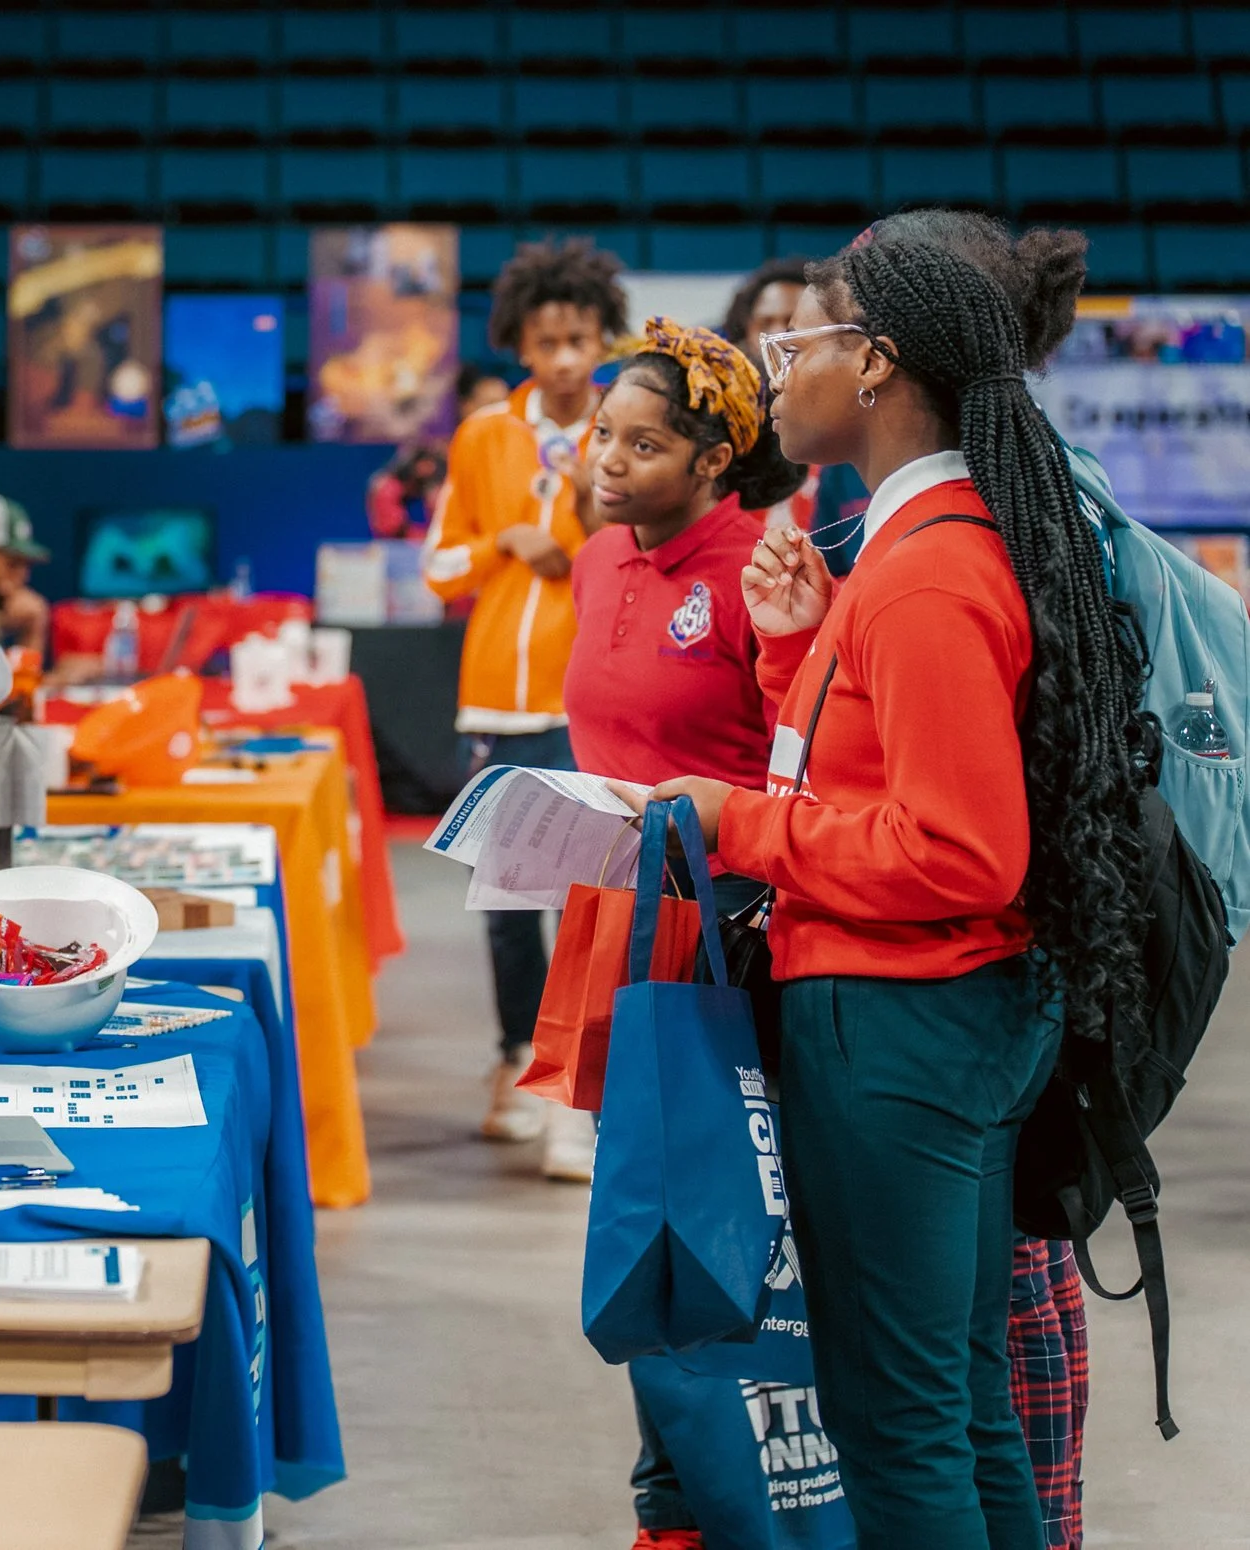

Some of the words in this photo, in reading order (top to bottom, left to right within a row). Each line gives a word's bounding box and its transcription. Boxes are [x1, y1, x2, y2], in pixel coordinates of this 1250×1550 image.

[442, 786, 487, 843] TECHNICAL
[761, 1316, 809, 1337] ntergy
[781, 1496, 797, 1510] to
[799, 1492, 823, 1507] the
